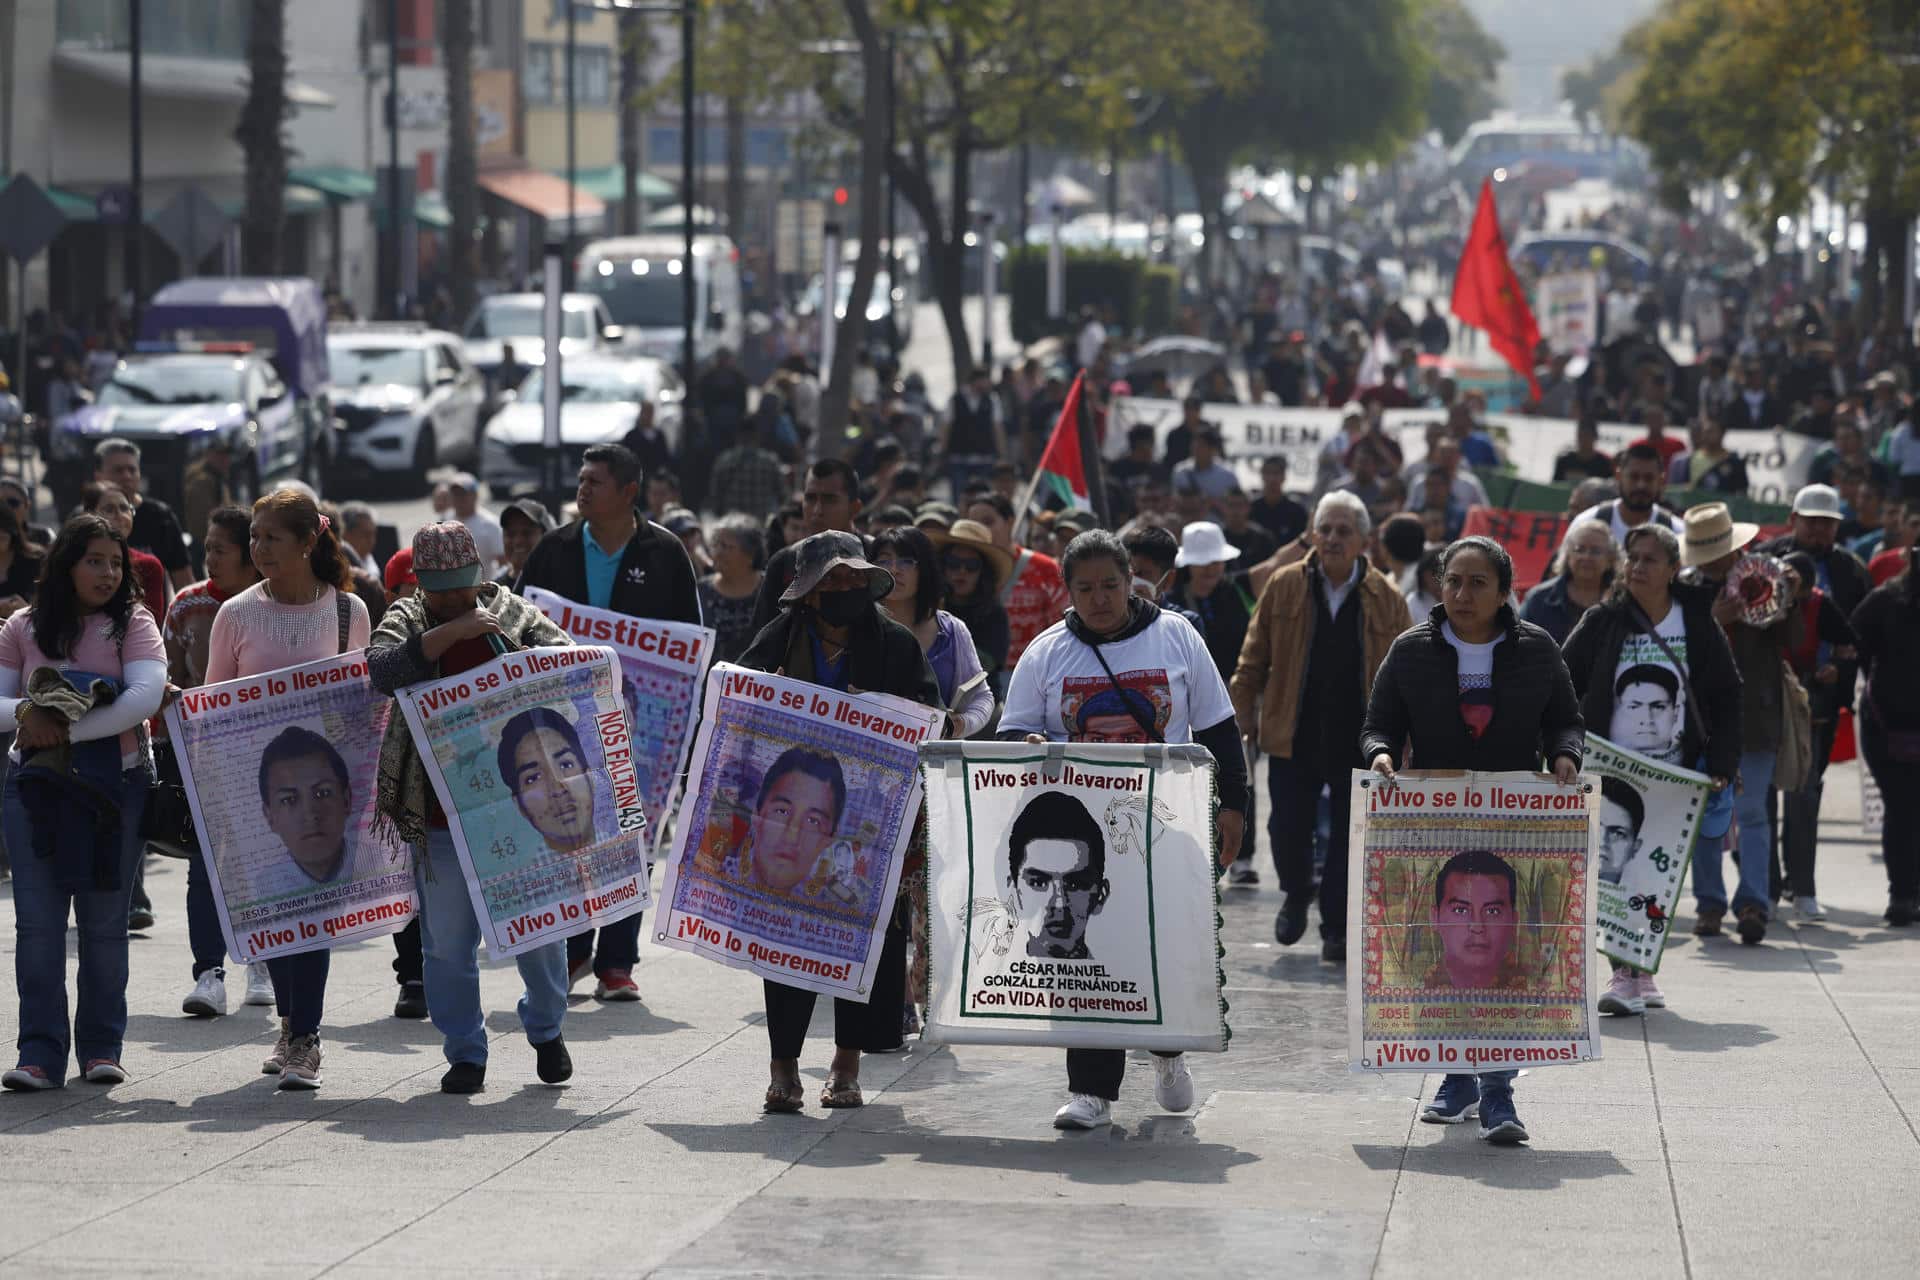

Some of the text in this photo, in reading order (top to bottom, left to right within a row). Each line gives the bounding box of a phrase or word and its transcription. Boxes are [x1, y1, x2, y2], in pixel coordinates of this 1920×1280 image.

[1246, 423, 1319, 444] BIEN
[543, 607, 702, 664] Justicia!
[418, 683, 471, 719] ¡Vivo
[475, 672, 500, 693] se
[502, 663, 523, 682] lo
[525, 648, 604, 675] llevaron!
[179, 691, 231, 721] ¡Vivo
[238, 684, 261, 702] se
[267, 679, 286, 697] lo
[724, 673, 775, 701] ¡Vivo
[780, 689, 805, 710] se
[810, 694, 829, 716] lo
[834, 701, 926, 745] llevaron!
[598, 710, 627, 747] NOS
[1594, 751, 1610, 764] se
[1612, 756, 1626, 770] lo
[975, 769, 1016, 790] ¡Vivo
[1020, 772, 1037, 787] se
[1063, 766, 1143, 792] llevaron!
[1371, 786, 1585, 811] ¡Vivo se lo llevaron!
[1649, 846, 1670, 873] 43
[274, 896, 309, 913] JOVANY
[507, 911, 556, 945] ¡Vivo
[559, 902, 579, 921] lo
[583, 877, 639, 917] queremos!
[691, 887, 737, 912] ANTONIO
[743, 907, 793, 929] SANTANA
[799, 921, 854, 944] MAESTRO
[247, 930, 295, 956] ¡Vivo
[299, 921, 317, 940] lo
[323, 895, 412, 936] queremos!
[677, 916, 721, 946] ¡Vivo
[724, 931, 742, 952] lo
[747, 942, 852, 981] queremos!
[1010, 960, 1110, 978] CÉSAR MANUEL
[983, 974, 1138, 994] GONZÁLEZ HERNÁNDEZ
[972, 990, 1148, 1013] ¡Con VIDA lo queremos!
[1469, 1006, 1517, 1019] CAMPOS
[1524, 1006, 1573, 1020] CANTOR
[1376, 1043, 1578, 1067] ¡Vivo lo queremos!
